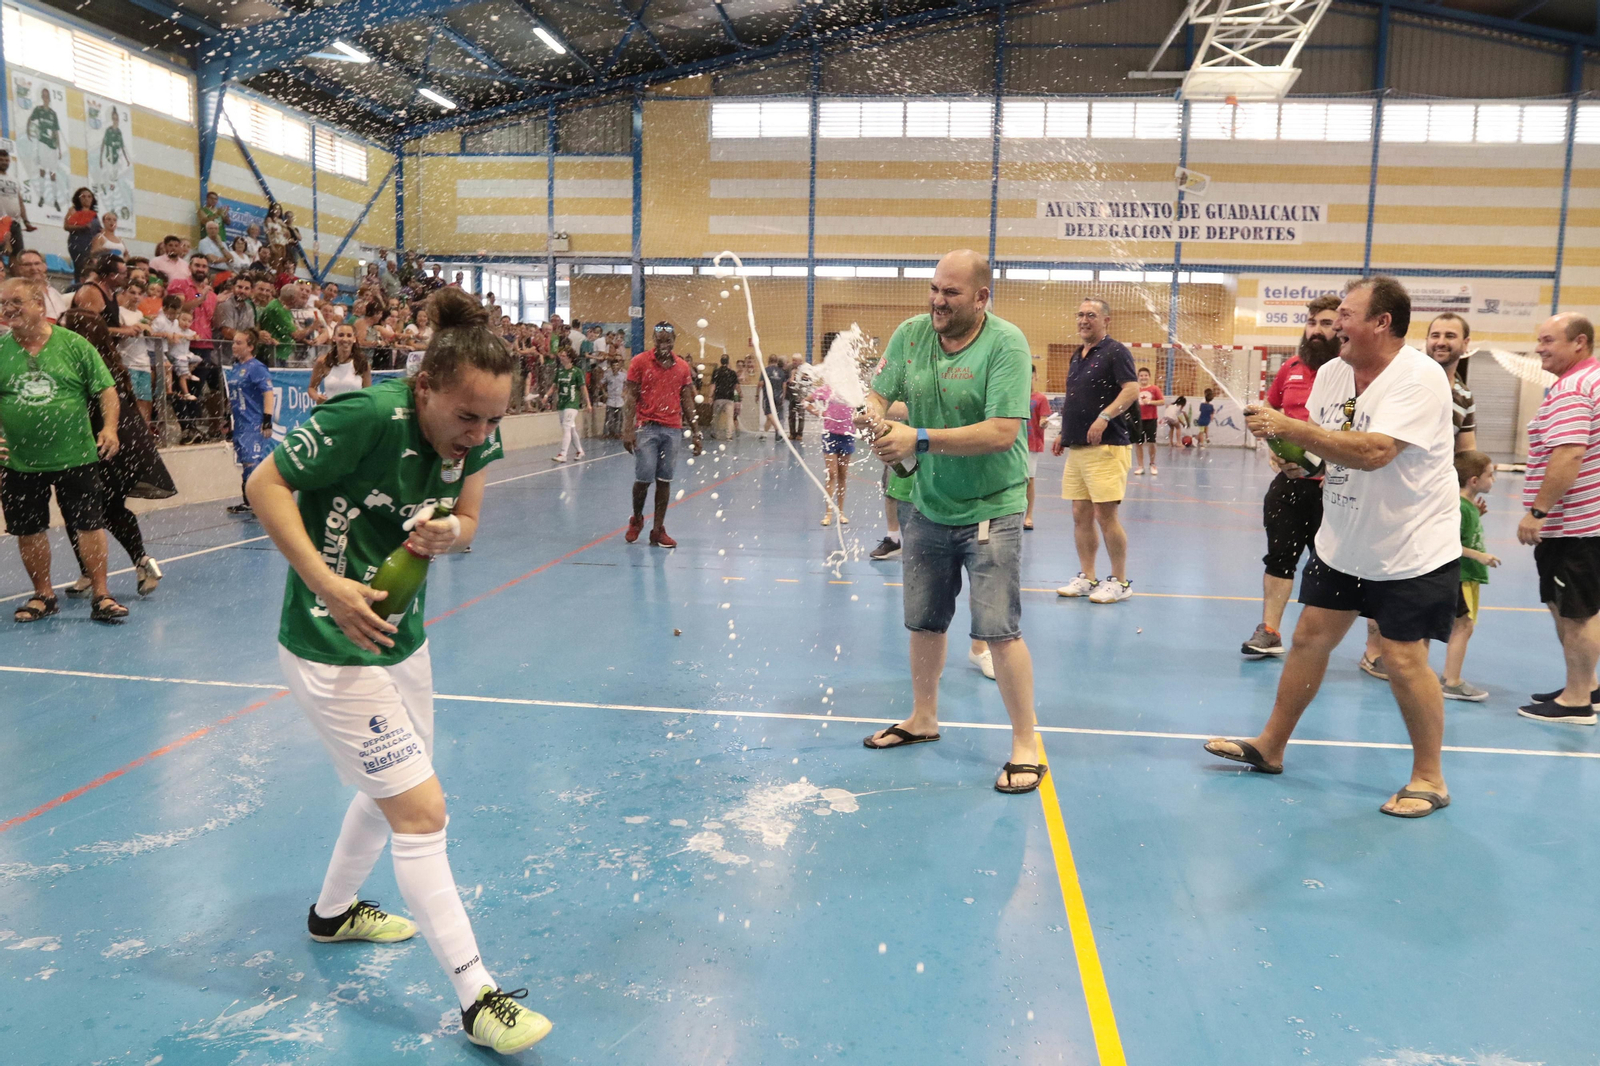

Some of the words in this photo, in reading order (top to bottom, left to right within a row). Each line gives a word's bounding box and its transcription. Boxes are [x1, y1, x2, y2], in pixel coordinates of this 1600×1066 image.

[52, 90, 62, 100] 15
[122, 112, 128, 122] 3
[23, 179, 31, 204] EVA
[1045, 201, 1173, 219] AYUNTAMIENTO
[1181, 202, 1200, 220] DE
[1205, 202, 1320, 222] GUADALCACIN
[1064, 222, 1173, 239] DELEGACION
[1179, 224, 1201, 240] DE
[1205, 225, 1296, 241] DEPORTES
[1265, 312, 1288, 324] 956
[1293, 313, 1309, 324] 30
[309, 496, 348, 618] tefurgo
[363, 727, 404, 748] DEPORTES
[363, 742, 418, 770] telefurgo
